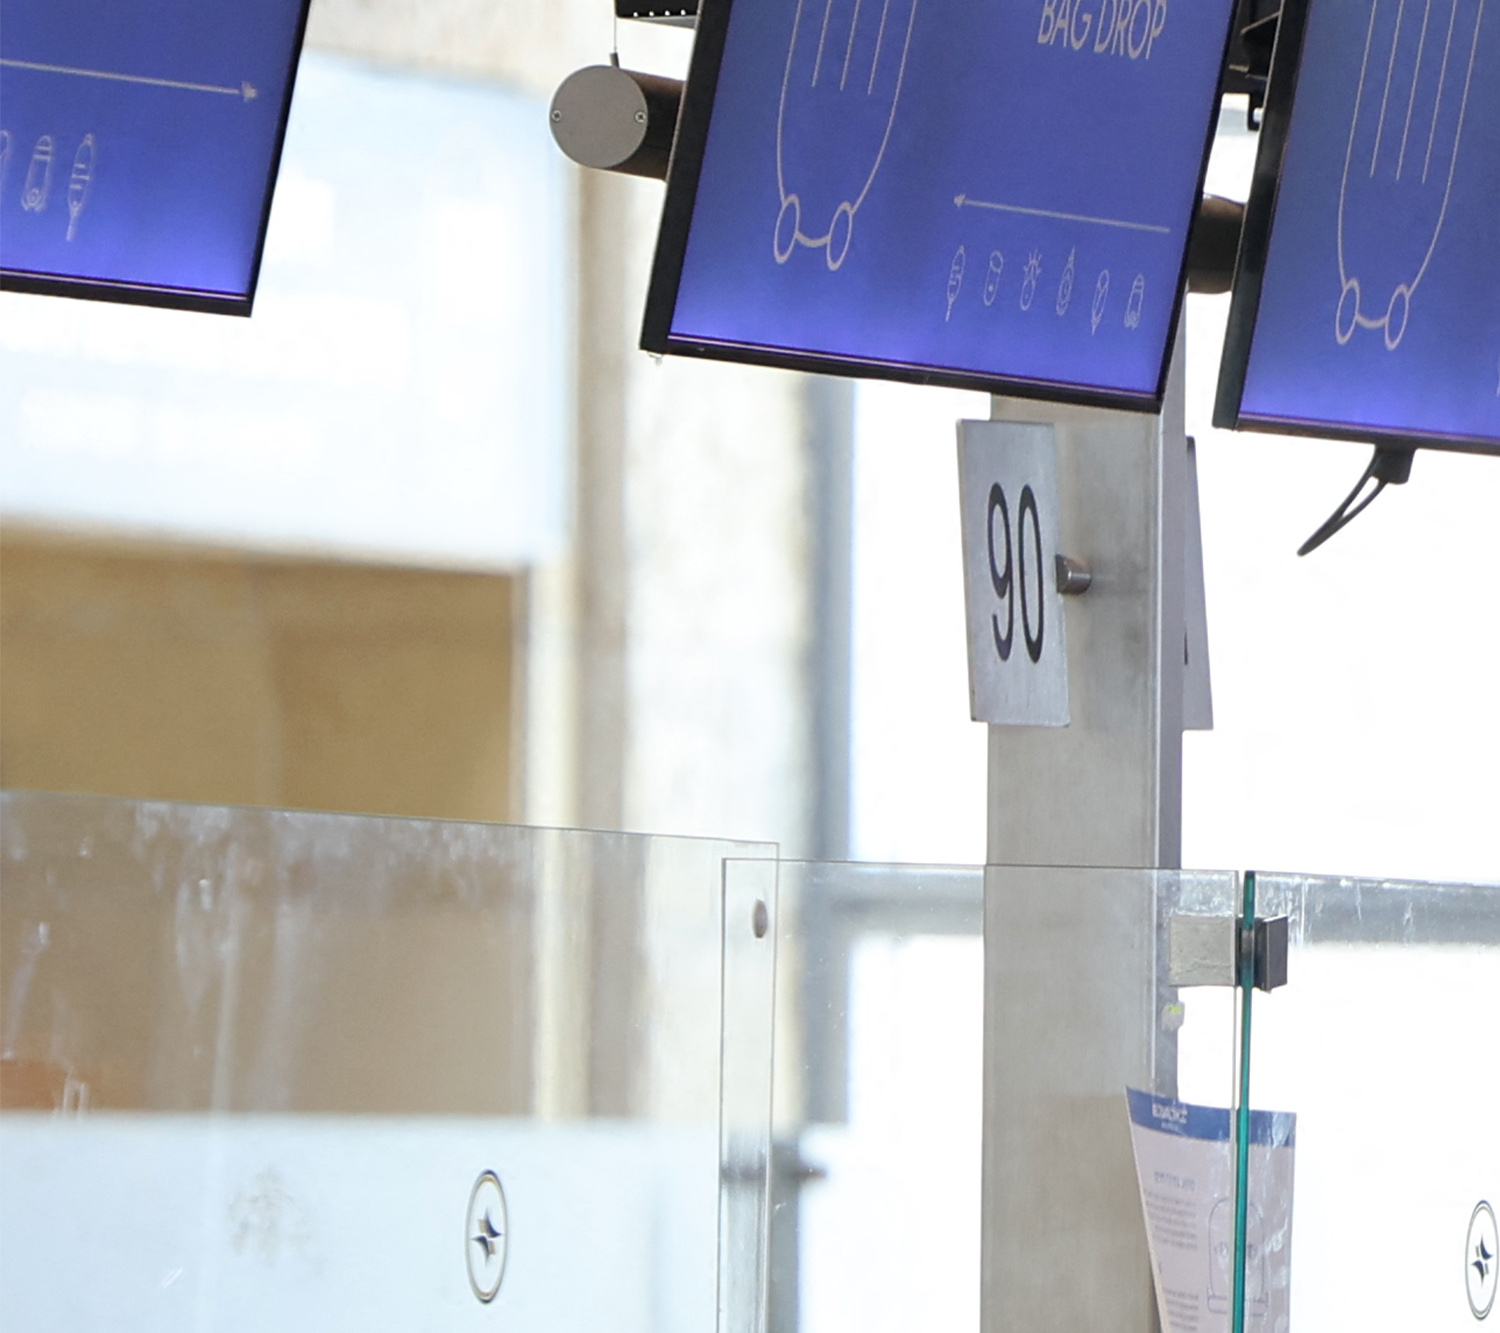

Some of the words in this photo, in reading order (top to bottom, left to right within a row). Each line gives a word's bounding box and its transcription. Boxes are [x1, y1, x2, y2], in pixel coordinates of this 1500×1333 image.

[1037, 0, 1092, 50] BAG
[1093, 0, 1167, 60] DROP
[986, 481, 1045, 664] 90
